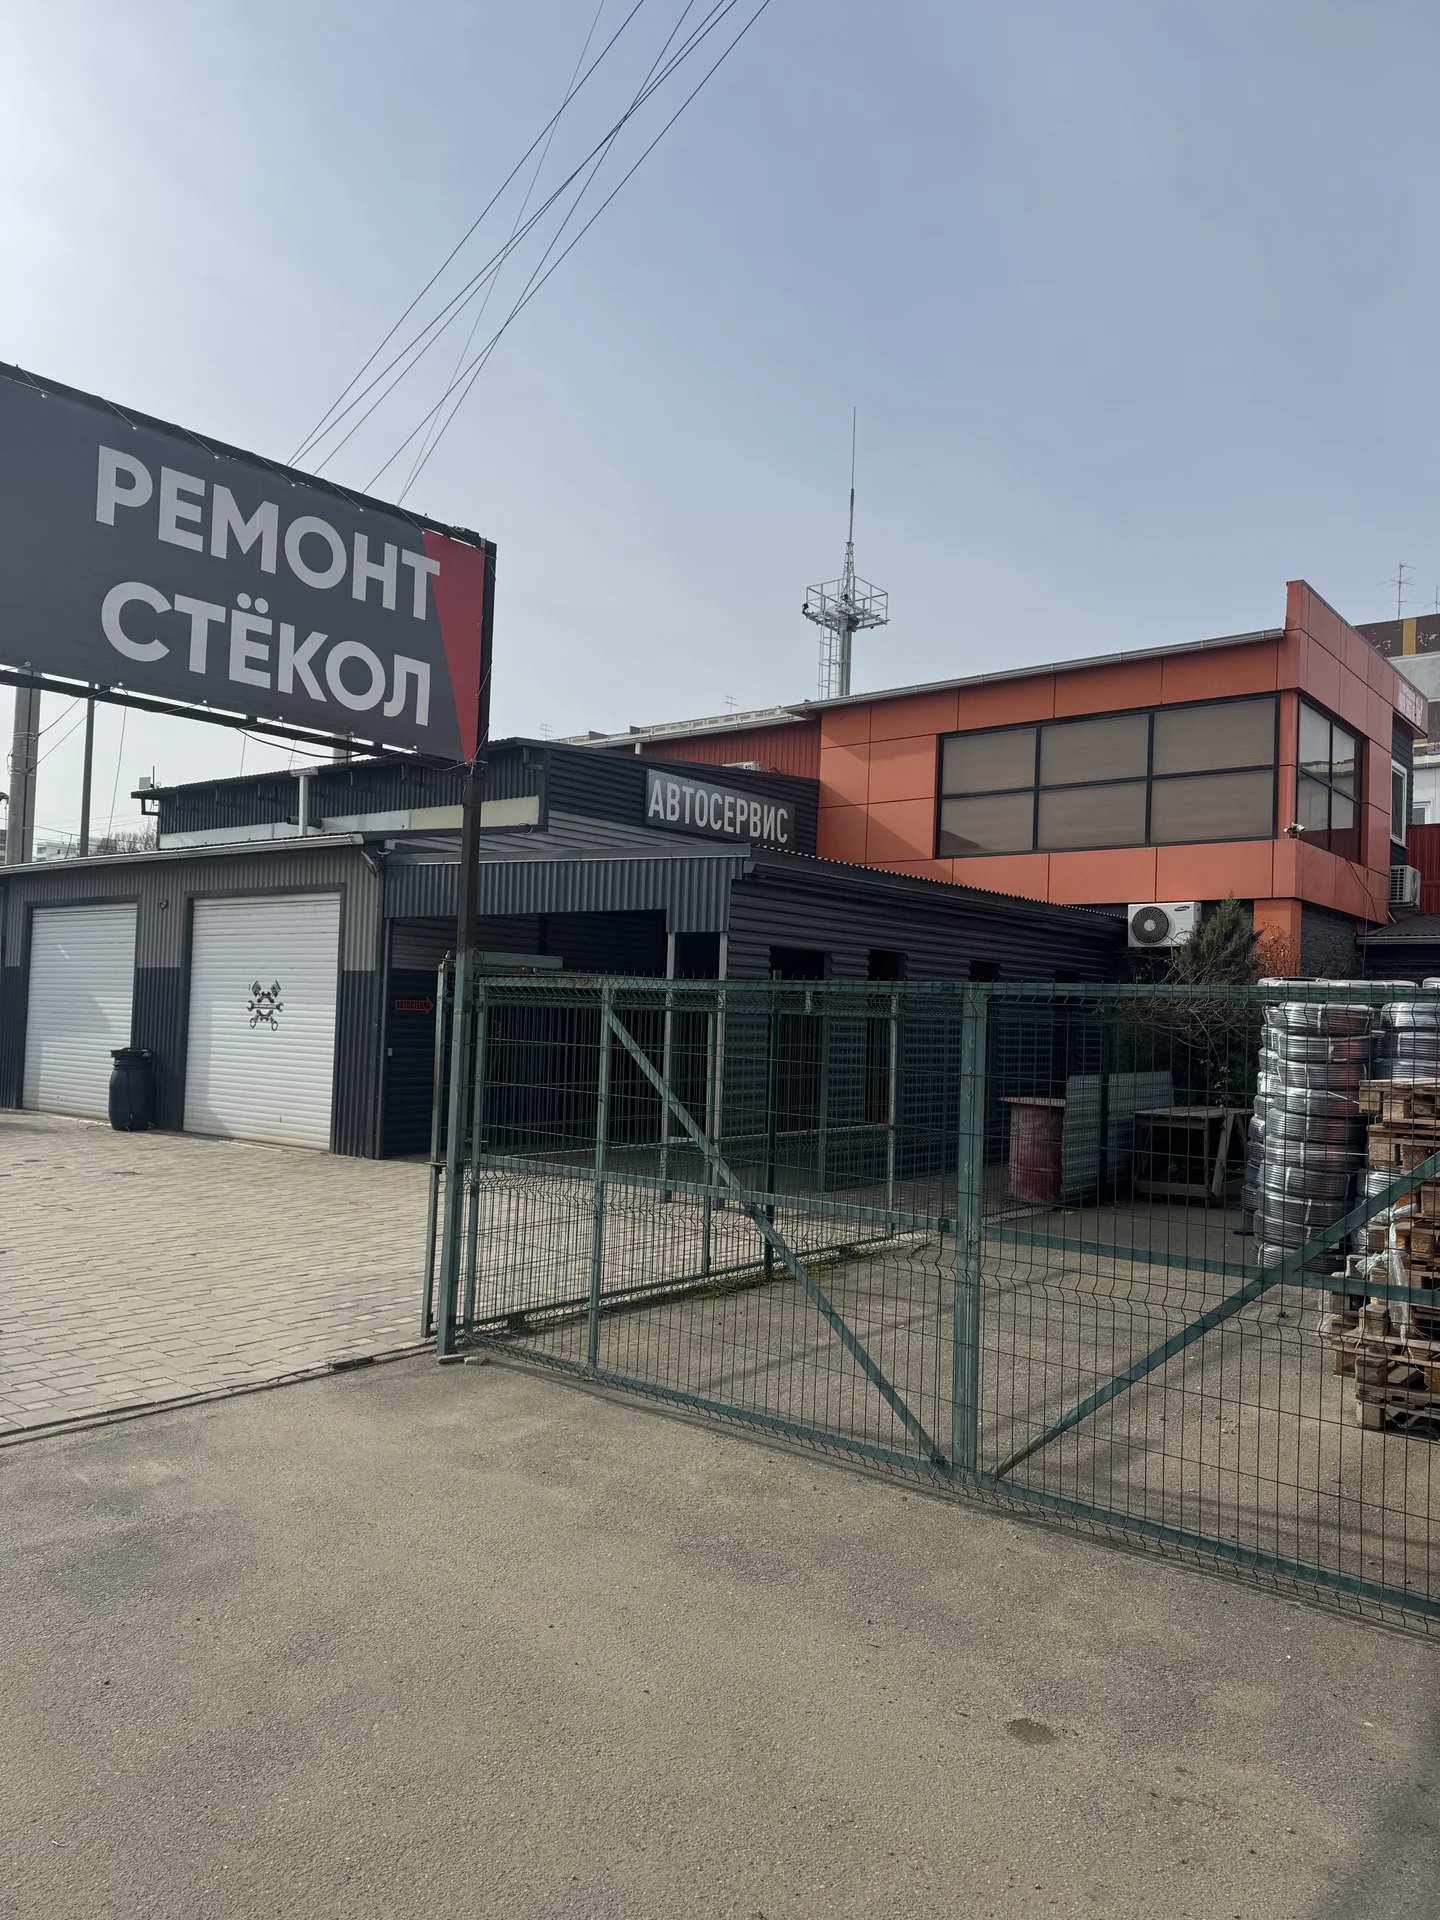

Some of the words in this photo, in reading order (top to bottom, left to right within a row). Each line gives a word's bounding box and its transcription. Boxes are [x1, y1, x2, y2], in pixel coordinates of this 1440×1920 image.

[96, 445, 440, 620] РЕМОНТ
[101, 581, 431, 726] СТЁКОЛ
[648, 779, 788, 844] АВТОСЕРВИС
